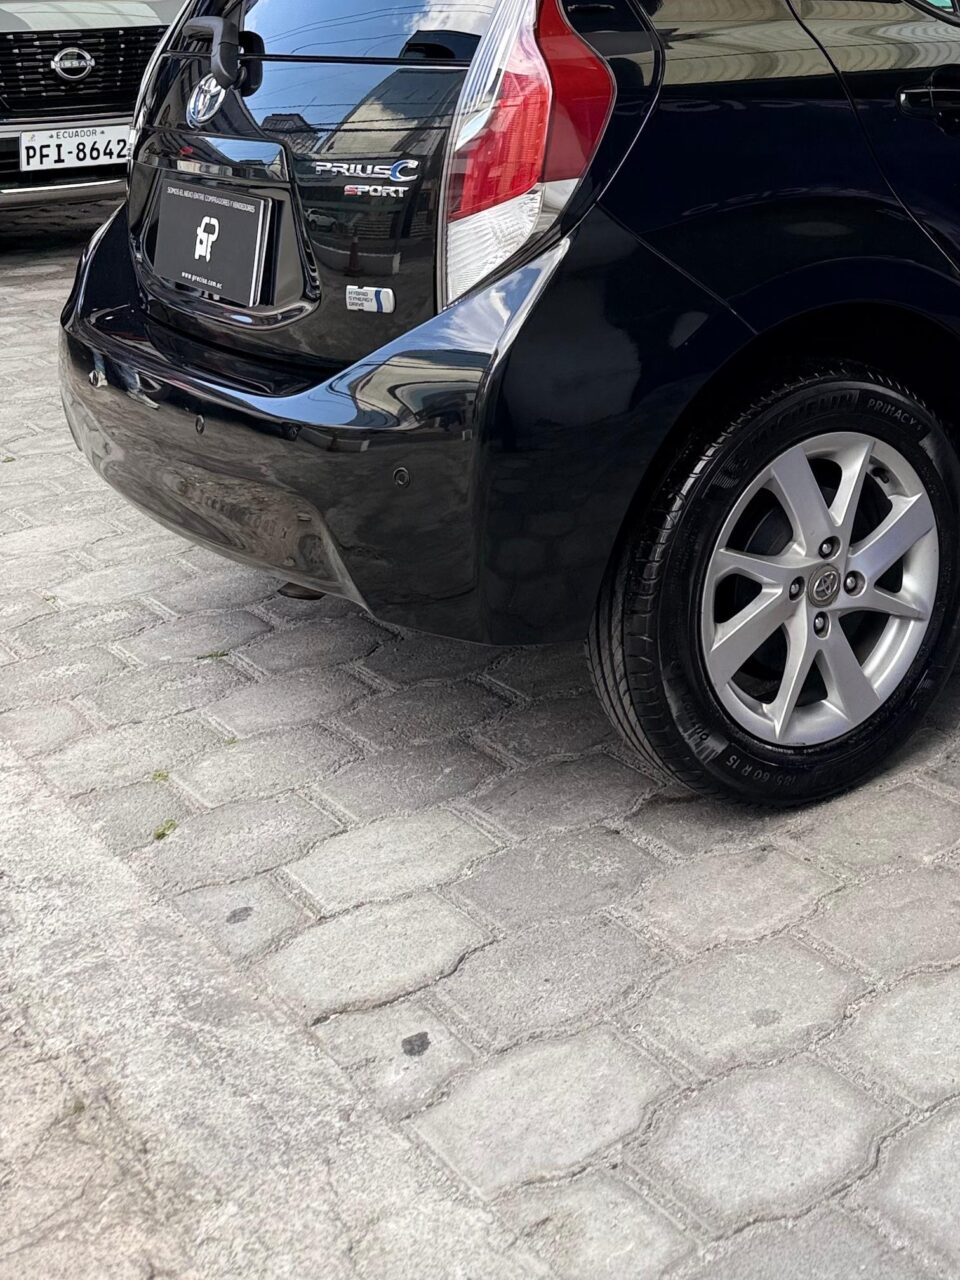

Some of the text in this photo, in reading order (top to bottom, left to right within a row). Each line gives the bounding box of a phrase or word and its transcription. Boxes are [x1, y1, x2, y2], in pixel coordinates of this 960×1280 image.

[51, 59, 95, 69] NISSAN
[56, 129, 97, 139] ECUADOR
[25, 139, 127, 166] PFI-8642
[344, 185, 409, 197] SPORT
